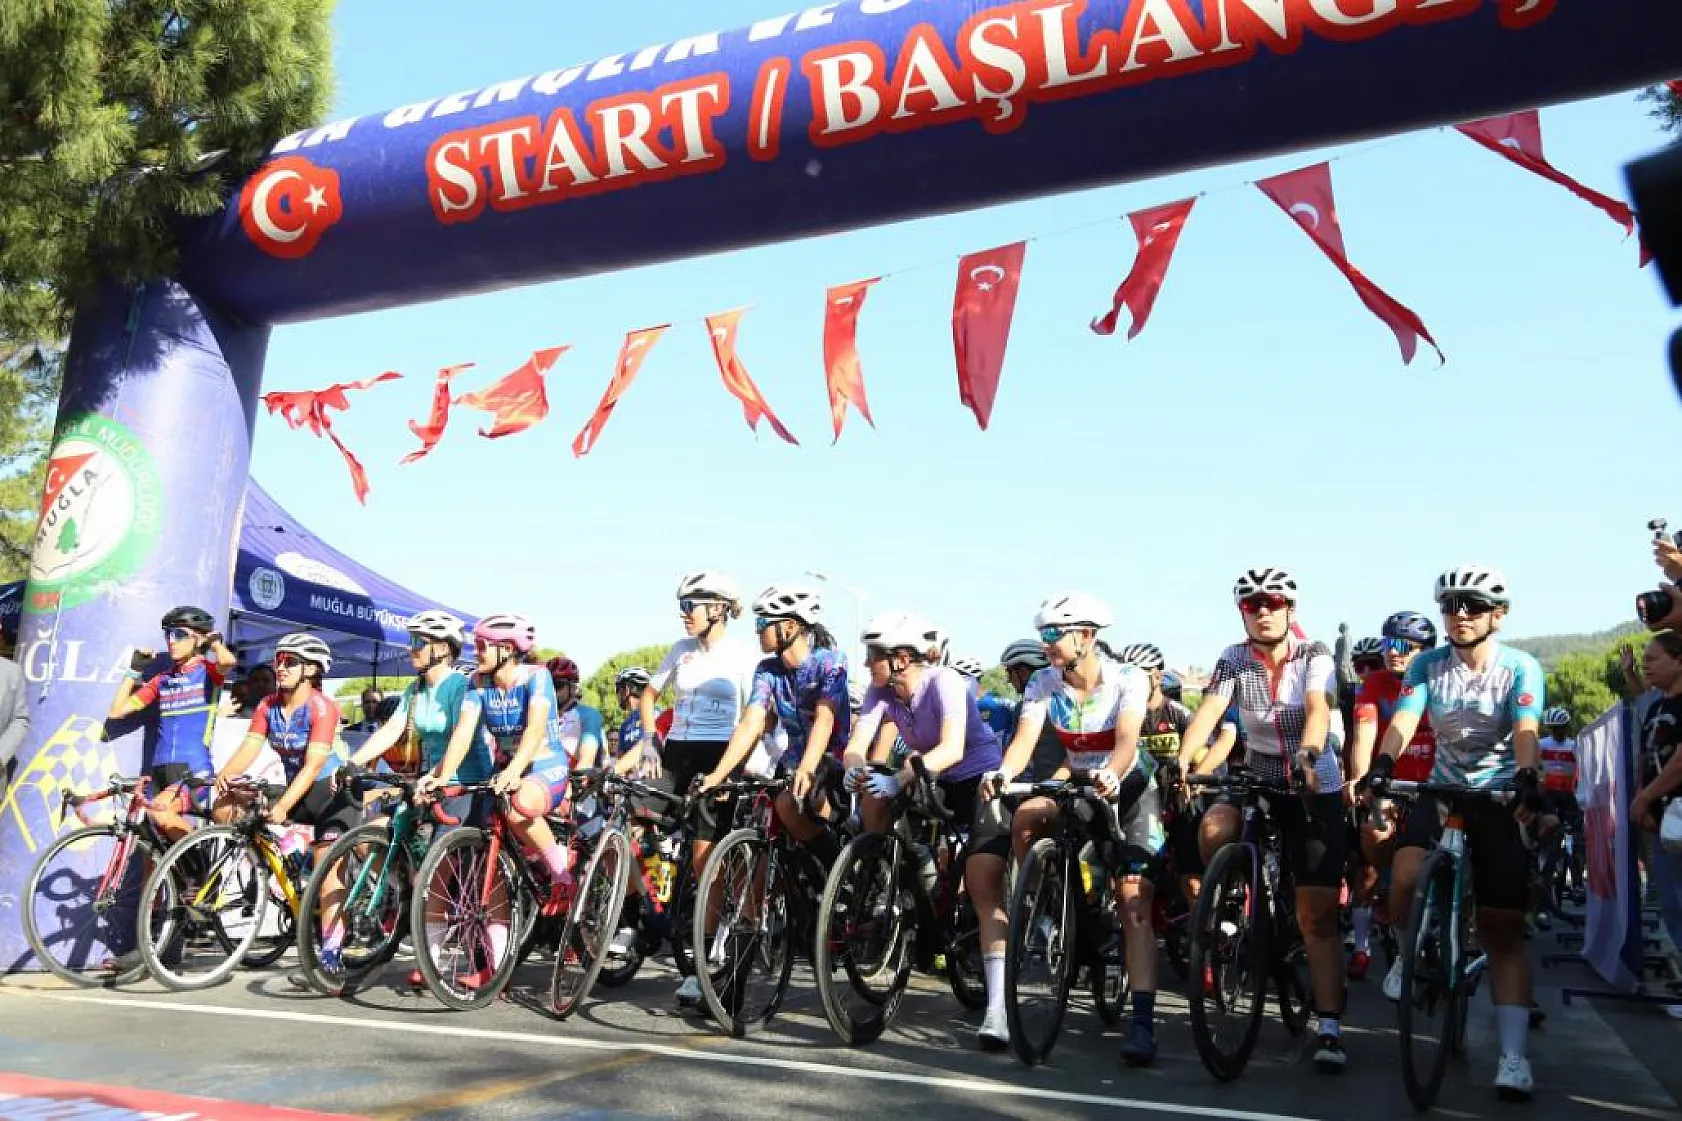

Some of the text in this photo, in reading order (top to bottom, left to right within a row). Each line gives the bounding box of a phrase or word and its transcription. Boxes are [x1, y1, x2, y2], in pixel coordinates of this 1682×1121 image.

[432, 82, 720, 215] START
[758, 65, 780, 151] /
[310, 594, 354, 618] MUĞLA
